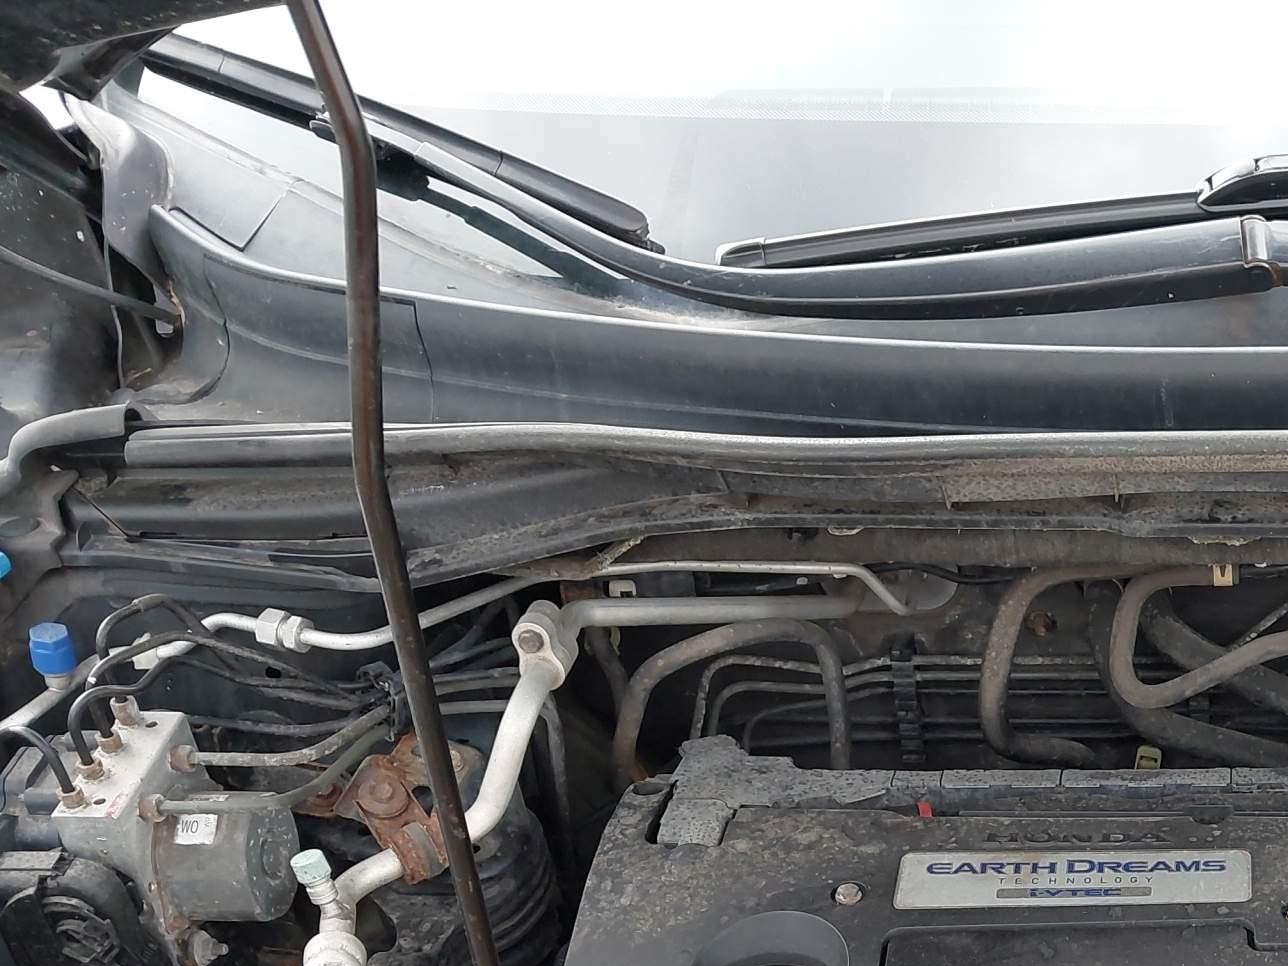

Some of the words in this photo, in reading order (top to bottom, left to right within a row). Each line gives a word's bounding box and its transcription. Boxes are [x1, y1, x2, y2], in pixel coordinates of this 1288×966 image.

[982, 831, 1171, 845] HONDA
[926, 862, 1058, 875] EARTH
[1066, 859, 1226, 874] DREAMS
[999, 876, 1153, 885] TECHNOLOGY
